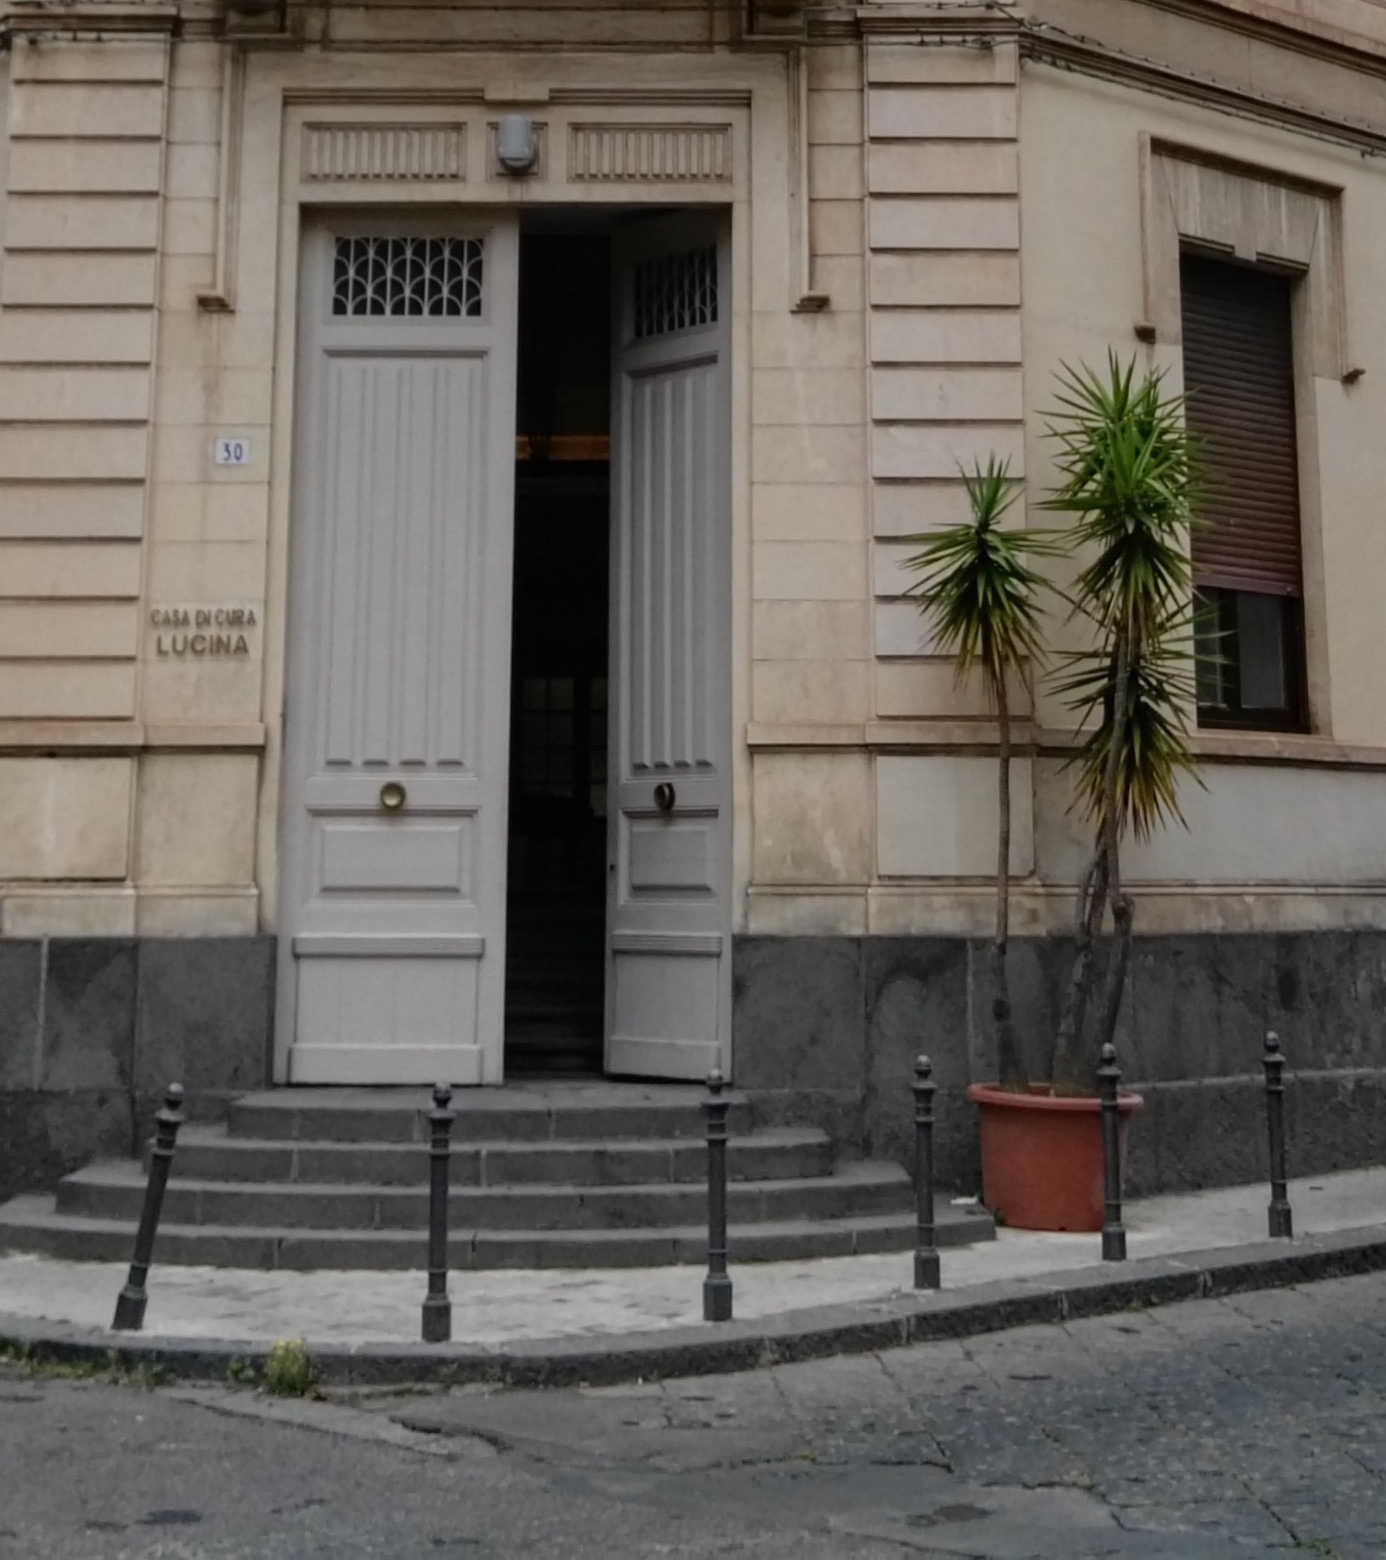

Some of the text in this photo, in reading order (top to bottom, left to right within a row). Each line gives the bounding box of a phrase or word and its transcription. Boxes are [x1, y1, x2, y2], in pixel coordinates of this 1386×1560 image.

[150, 607, 257, 628] CASA DI CURA
[156, 633, 250, 656] LUCINA
